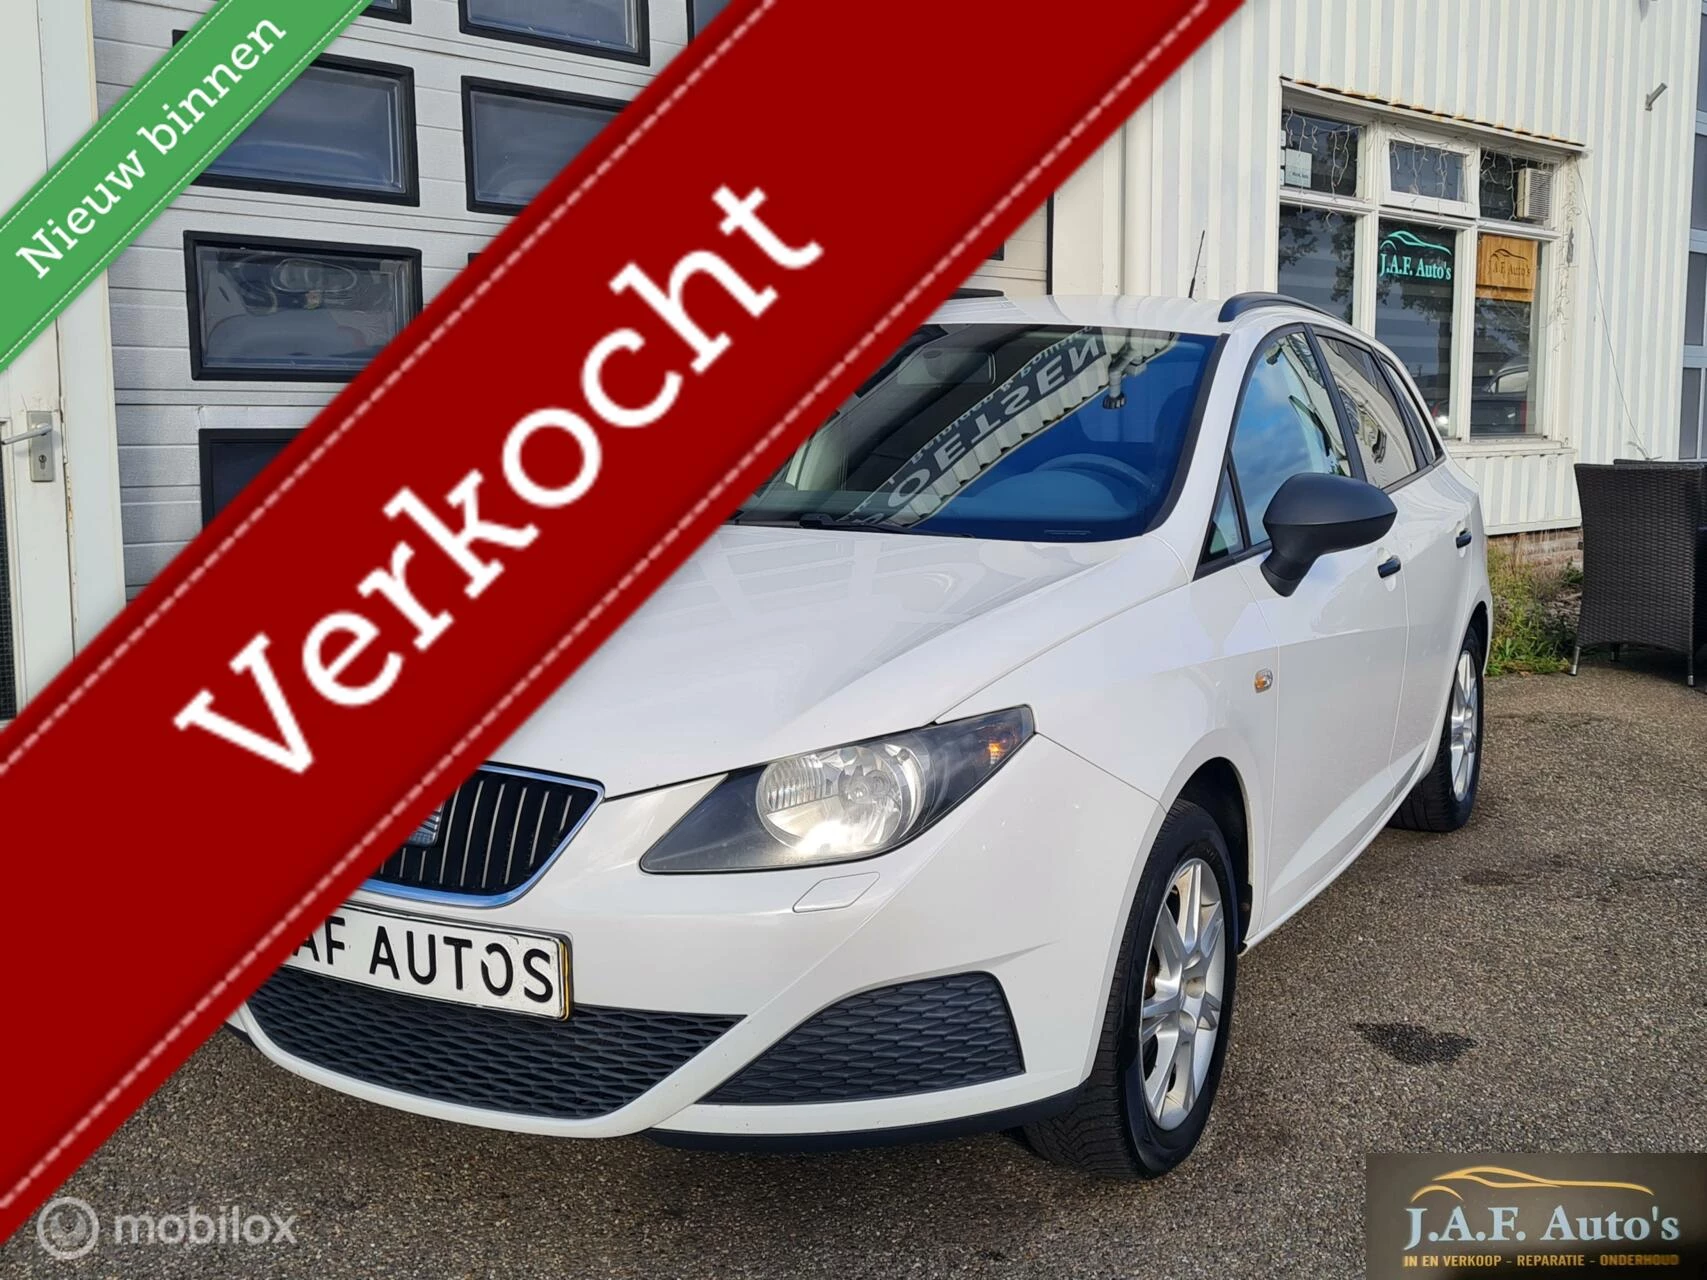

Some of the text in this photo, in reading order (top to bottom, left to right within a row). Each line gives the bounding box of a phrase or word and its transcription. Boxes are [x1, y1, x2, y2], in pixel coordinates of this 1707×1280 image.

[1380, 253, 1452, 280] J.A.F. Auto's
[368, 925, 555, 1004] AUTOS
